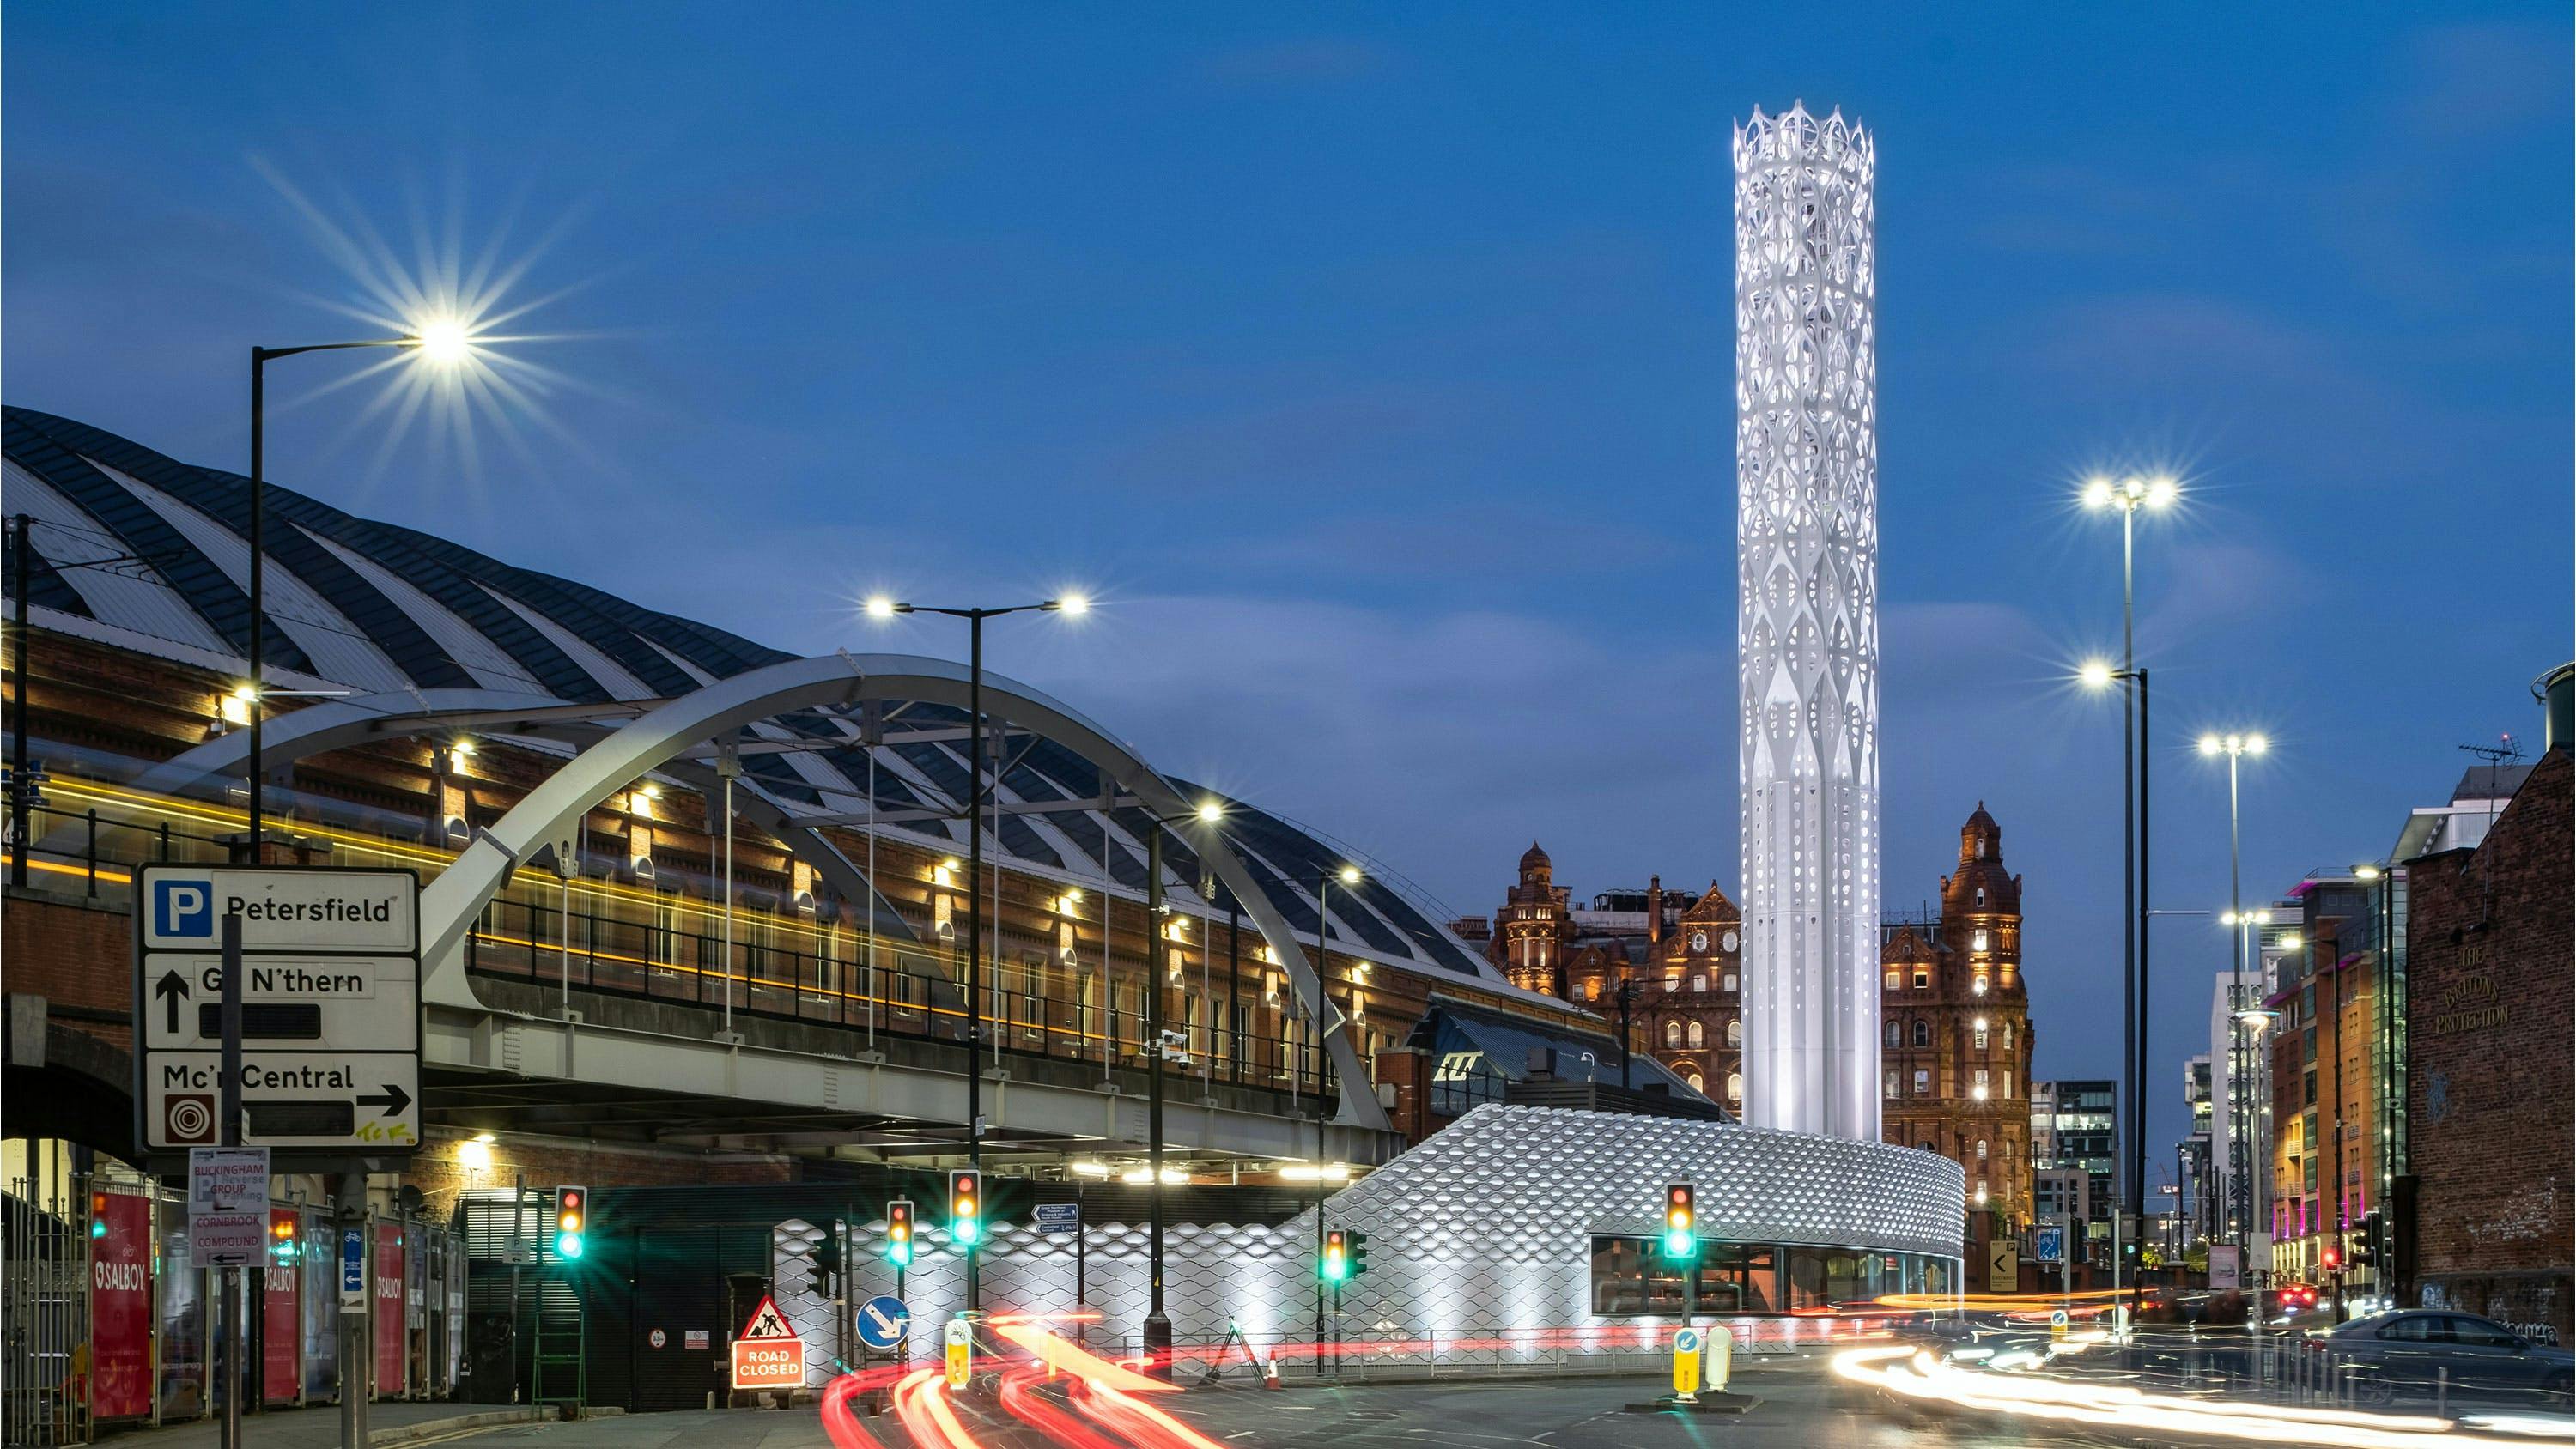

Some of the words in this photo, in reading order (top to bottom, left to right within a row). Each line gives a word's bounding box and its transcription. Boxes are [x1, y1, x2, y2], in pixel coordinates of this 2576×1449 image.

[228, 896, 390, 922] Petersfield
[252, 968, 363, 992] N'thern
[2436, 1004, 2508, 1034] PROTECTION
[164, 1064, 222, 1089] Mc'
[241, 1064, 354, 1088] Central
[194, 1164, 264, 1176] BUCKINGHAM
[210, 1185, 246, 1195] GROUP
[197, 1216, 260, 1228] CORNBROOK
[197, 1236, 258, 1247] COMPOUND
[106, 1263, 145, 1291] SALBOY
[269, 1269, 295, 1292] SALBOY
[381, 1277, 402, 1299] SALBOY
[748, 1351, 790, 1363] ROAD
[739, 1364, 799, 1377] CLOSED
